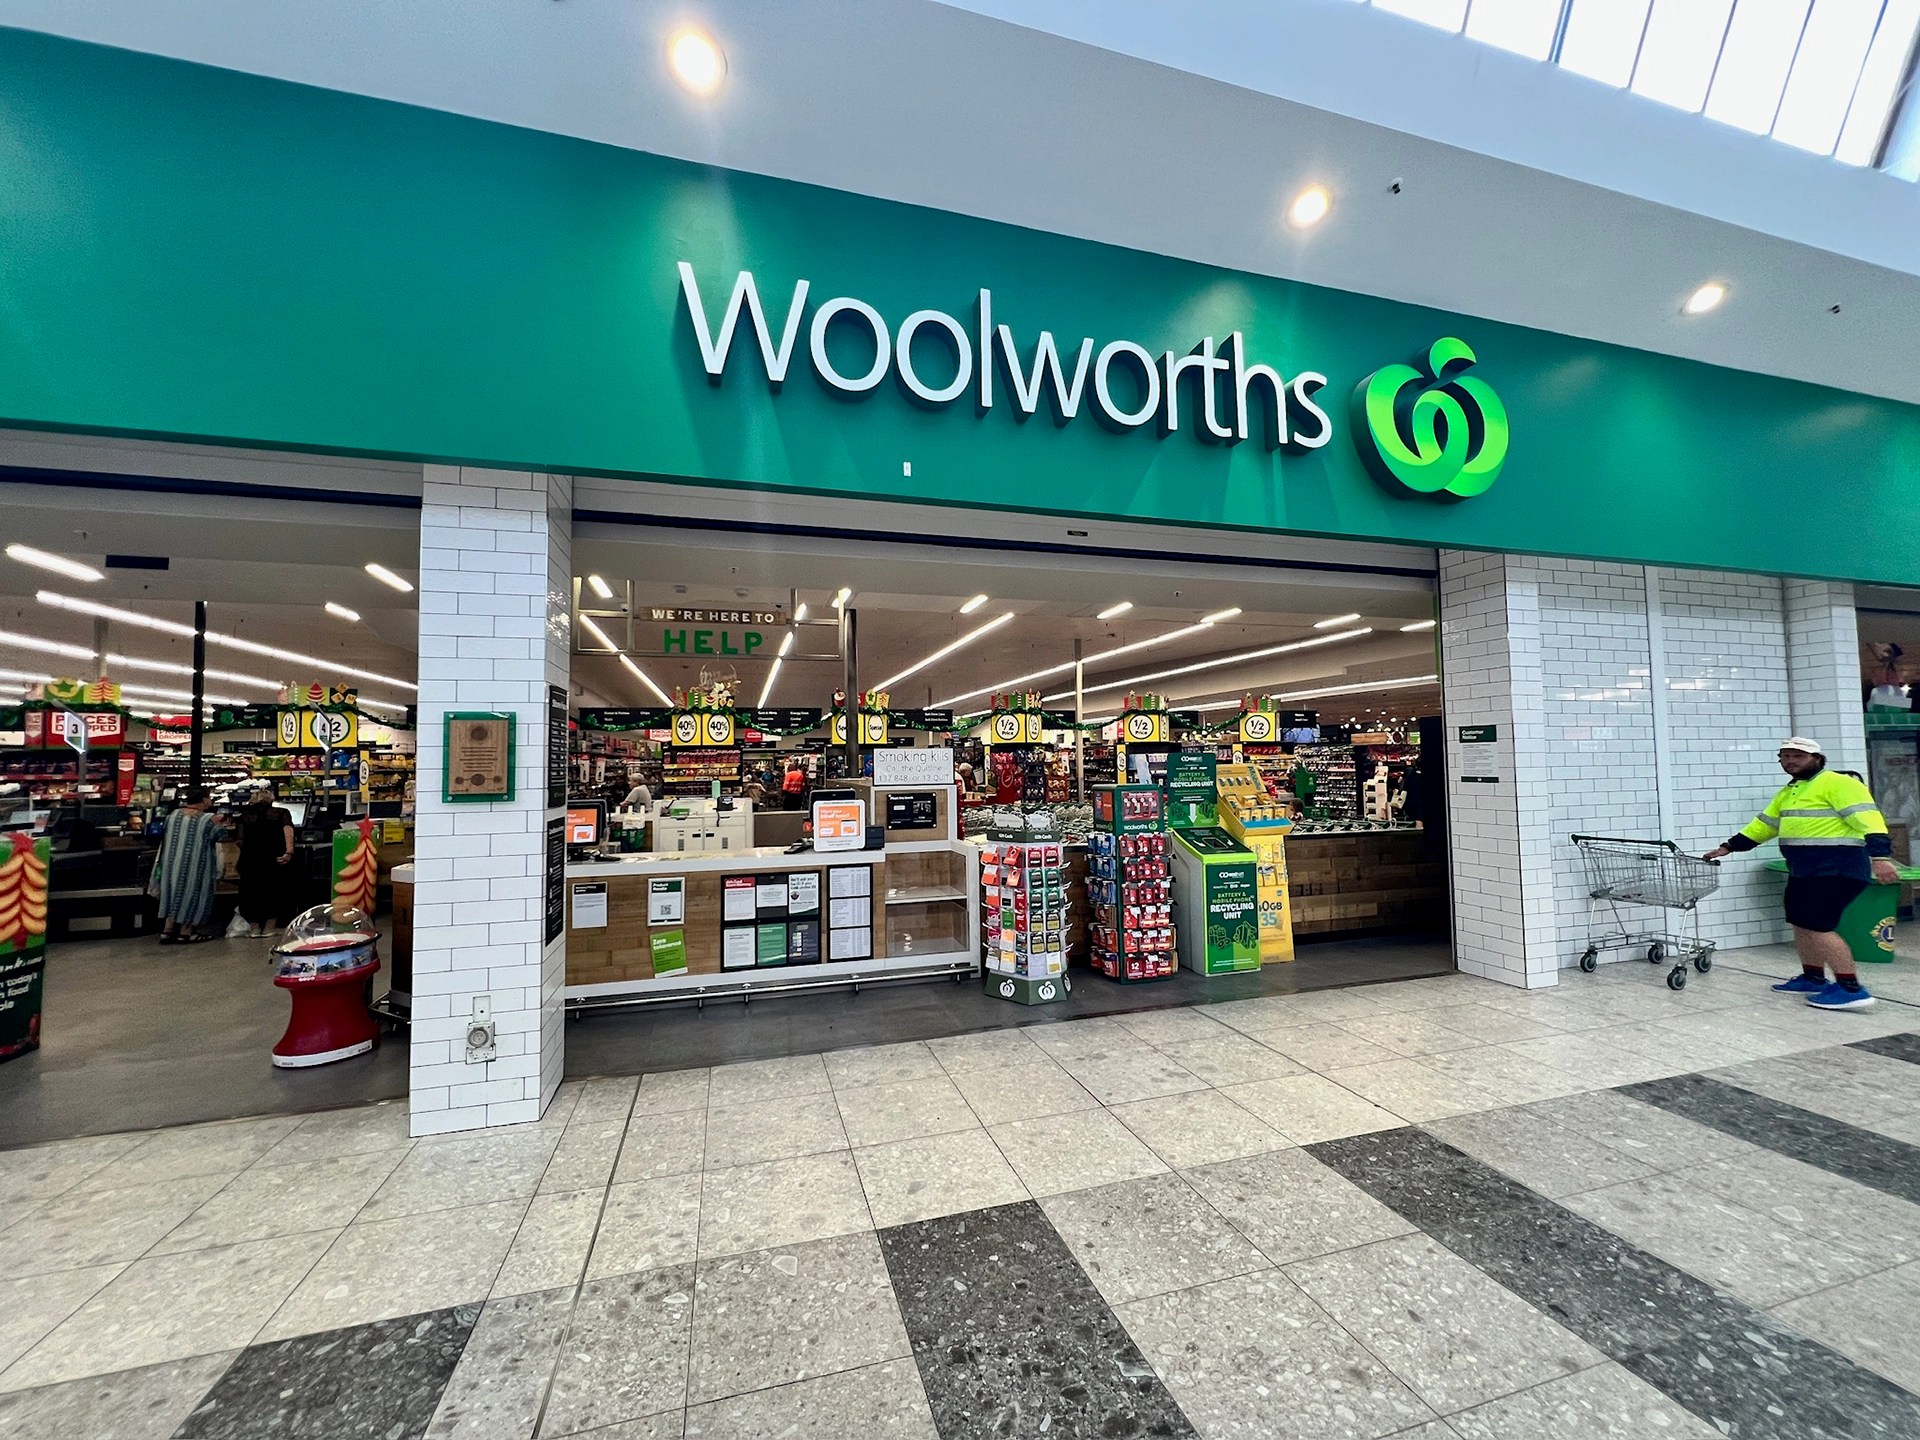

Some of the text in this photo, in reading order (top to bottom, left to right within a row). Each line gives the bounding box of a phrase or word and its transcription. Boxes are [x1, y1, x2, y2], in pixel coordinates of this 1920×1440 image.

[677, 261, 1332, 450] Woolworths
[652, 608, 775, 623] WE'RE HERE TO
[663, 629, 763, 655] HELP
[55, 715, 117, 725] PCES
[678, 720, 695, 732] 40%
[1000, 719, 1015, 731] 1/2
[1134, 719, 1149, 731] 1/2
[1250, 719, 1265, 731] 1/2
[71, 723, 79, 735] 3
[321, 722, 327, 734] 4
[710, 721, 728, 732] 40%
[878, 750, 949, 765] Smoking kills
[886, 764, 900, 773] Call
[915, 764, 943, 773] Quitline
[878, 774, 892, 782] 137
[893, 774, 909, 782] 848
[933, 773, 949, 781] QUIT
[1169, 780, 1200, 788] RECYCLING
[1210, 901, 1255, 913] RECYCLING
[1223, 911, 1242, 920] UNIT
